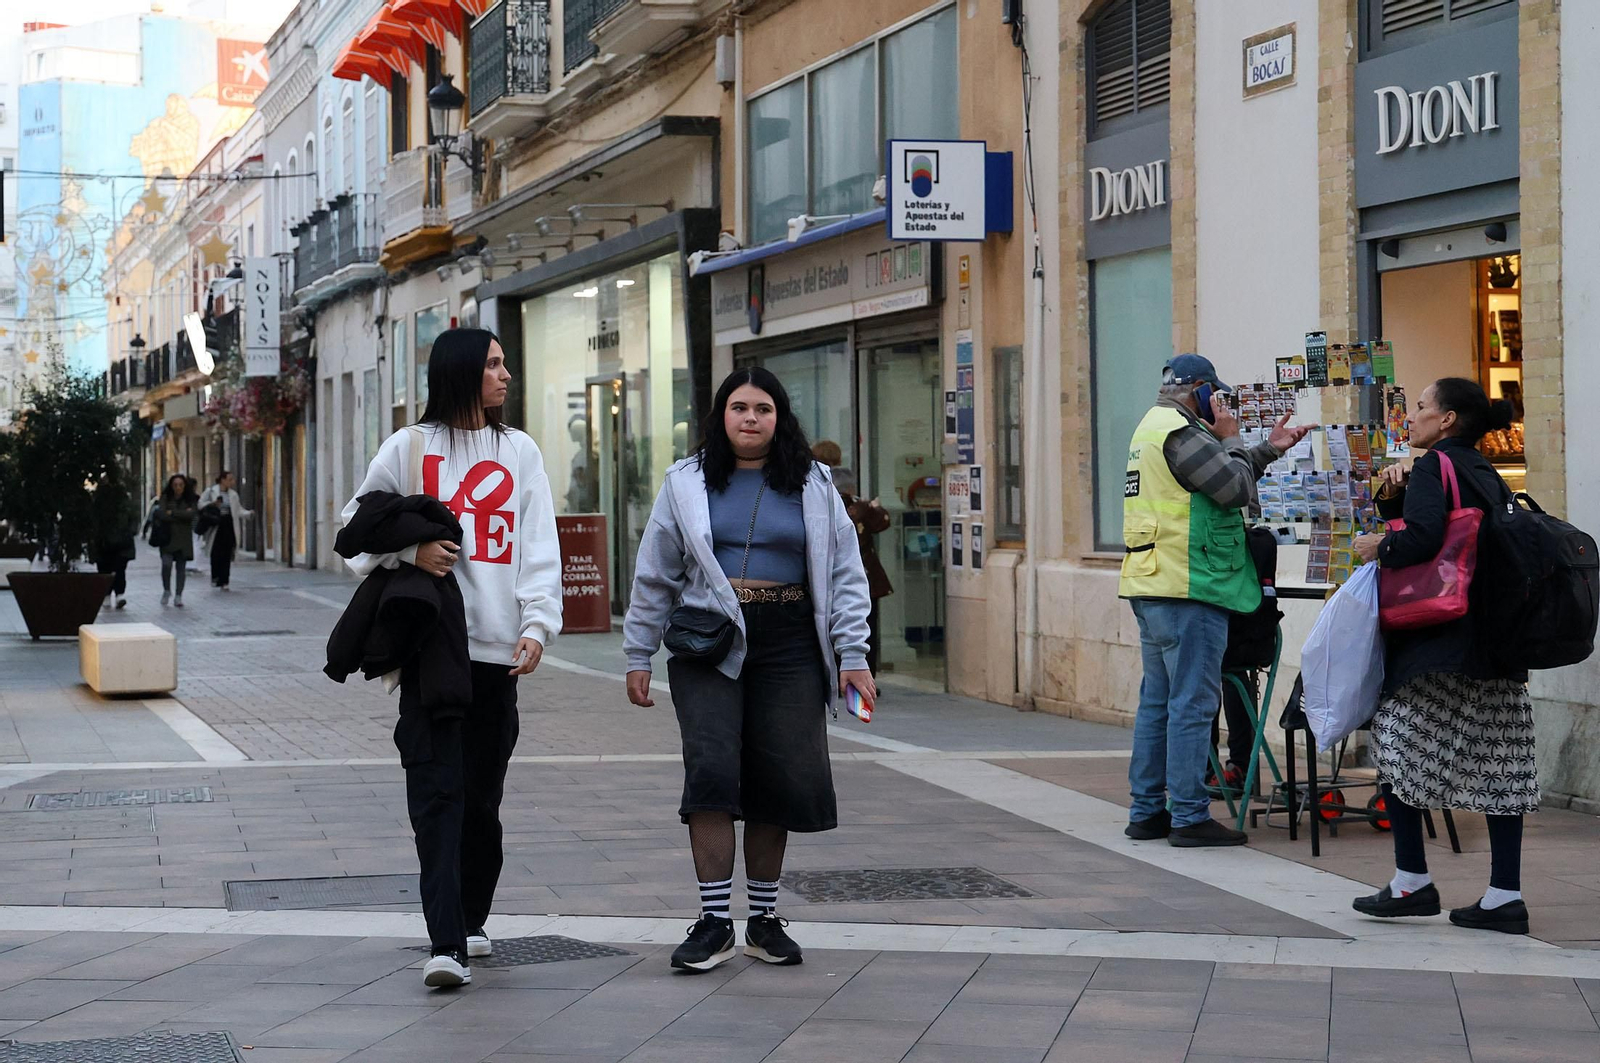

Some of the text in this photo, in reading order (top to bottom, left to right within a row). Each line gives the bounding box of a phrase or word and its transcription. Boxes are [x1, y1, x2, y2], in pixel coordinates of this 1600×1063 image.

[1260, 40, 1279, 56] CALLE
[1252, 56, 1286, 83] BOCAS
[1374, 71, 1499, 155] DIONI
[1088, 159, 1166, 221] DIONI
[904, 199, 950, 211] Loterías y
[905, 211, 965, 222] Apuestas del
[904, 222, 937, 231] Estado
[804, 267, 816, 294] del
[818, 259, 848, 291] Estado
[256, 269, 269, 345] NOVIAS
[569, 555, 593, 564] TRAJE
[564, 564, 599, 573] CAMISA
[562, 573, 602, 581] CORBATA
